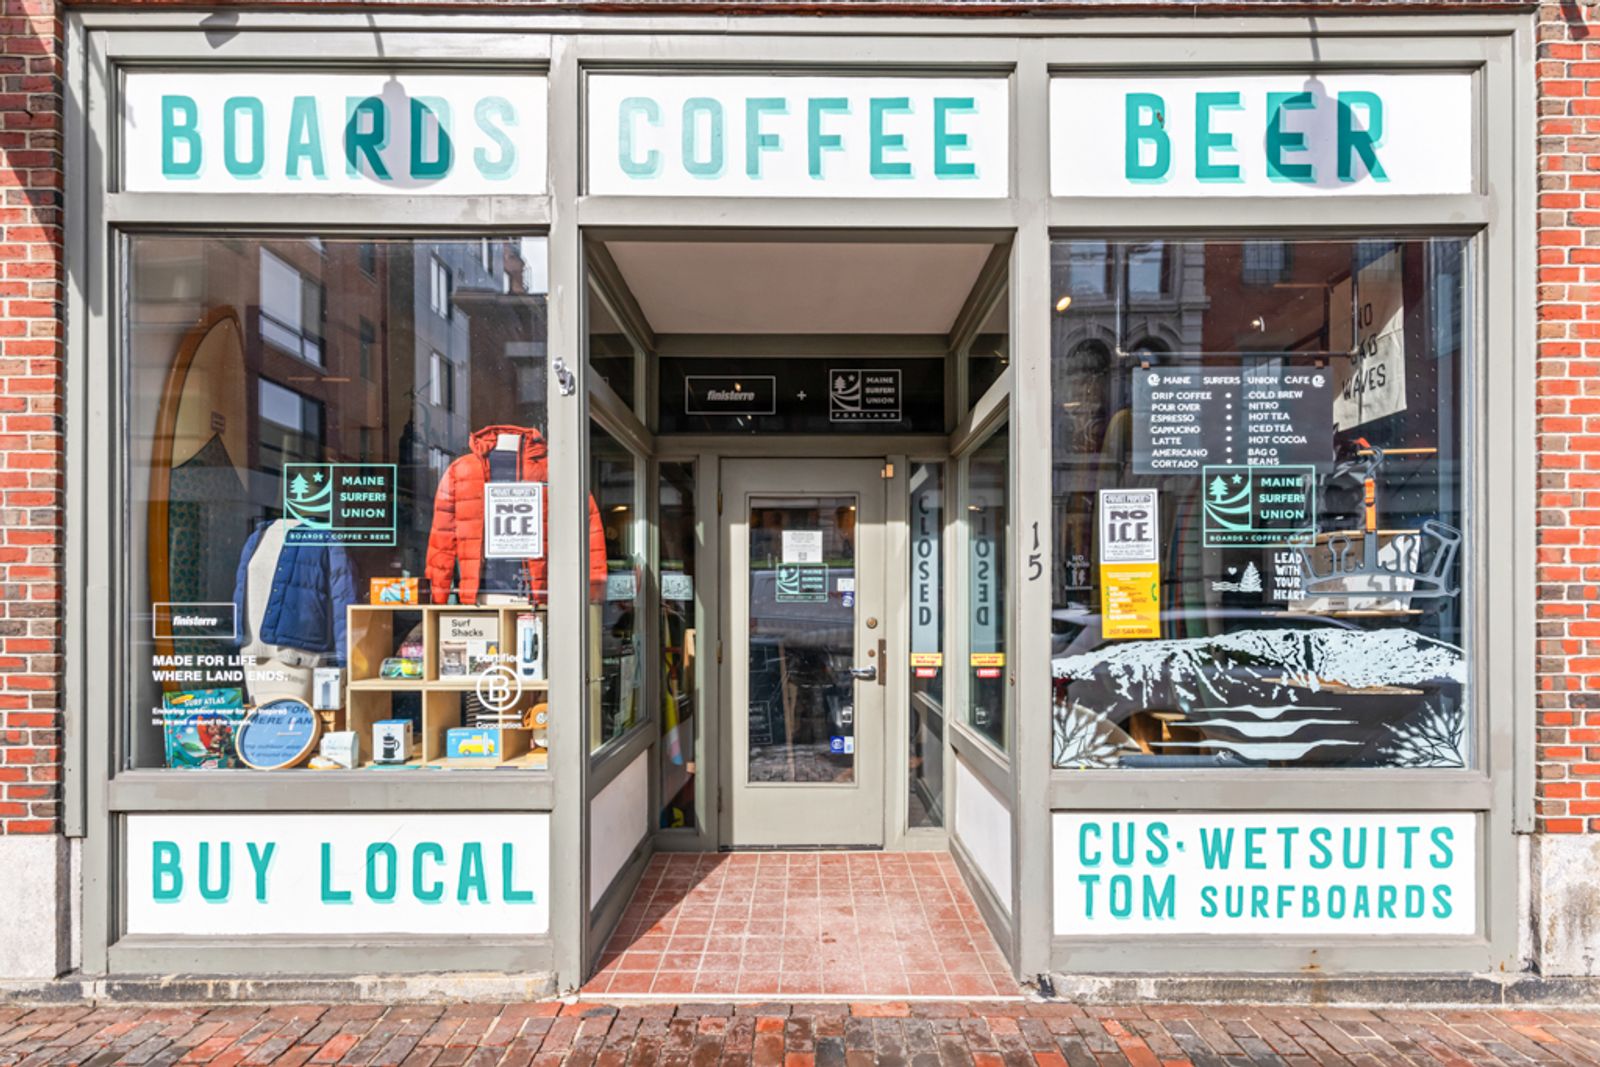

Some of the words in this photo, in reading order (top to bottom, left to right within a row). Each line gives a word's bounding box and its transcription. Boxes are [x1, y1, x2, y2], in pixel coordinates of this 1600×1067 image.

[161, 94, 519, 181] BOARDS
[617, 96, 981, 180] COFFEE
[1125, 91, 1392, 184] BEER
[866, 376, 894, 384] MAINE
[1163, 376, 1191, 385] MAINE
[1203, 376, 1240, 385] SURFERS
[1247, 376, 1278, 385] UNION
[1284, 376, 1310, 384] CAFE
[1152, 392, 1174, 400] DRIP
[1176, 392, 1212, 400] COFFEE
[1248, 391, 1275, 399] COLD
[1277, 390, 1303, 398] BREW
[866, 396, 895, 404] UNION
[1151, 403, 1176, 411] POUR
[1177, 403, 1201, 411] OVER
[1248, 401, 1279, 410] NITRO
[1151, 414, 1195, 422] ESPRESSO
[1248, 413, 1268, 421] HOT
[1271, 412, 1290, 420] TEA
[1248, 424, 1273, 432] ICED
[1275, 424, 1293, 432] TEA
[1152, 437, 1182, 445] LATTE
[1248, 436, 1269, 444] HOT
[1272, 436, 1307, 444] COCOA
[1151, 449, 1208, 457] AMERICANO
[1248, 448, 1268, 456] BAG
[1269, 448, 1278, 456] O
[1151, 460, 1198, 468] CORTADO
[1247, 457, 1280, 465] BEANS
[342, 476, 385, 486] MAINE
[1261, 477, 1303, 487] MAINE
[341, 508, 386, 518] UNION
[495, 503, 534, 514] NO
[1110, 510, 1149, 520] NO
[1260, 509, 1305, 519] UNION
[493, 515, 537, 537] I.C.E.
[330, 533, 363, 541] COFFEE
[1108, 522, 1153, 543] I.C.E.
[917, 495, 932, 626] CLOSED
[1274, 552, 1303, 564] LEAD
[1274, 564, 1301, 576] WITH
[1274, 577, 1301, 588] YOUR
[1273, 589, 1306, 600] HEART
[172, 615, 218, 626] finisterre
[451, 619, 471, 628] Surf
[451, 628, 484, 637] Shacks
[152, 655, 193, 667] MADE
[197, 655, 224, 667] FOR
[227, 655, 257, 667] LIFE
[152, 670, 202, 682] WHERE
[206, 670, 243, 682] LAND
[247, 670, 289, 682] ENDS.
[203, 697, 225, 706] ATLAS
[152, 708, 185, 716] Enduring
[1199, 826, 1454, 870] WETSUITS
[152, 840, 278, 904] BUY
[321, 842, 537, 905] LOCAL
[1078, 873, 1177, 920] TOM
[1200, 884, 1453, 919] SURFBOARDS
